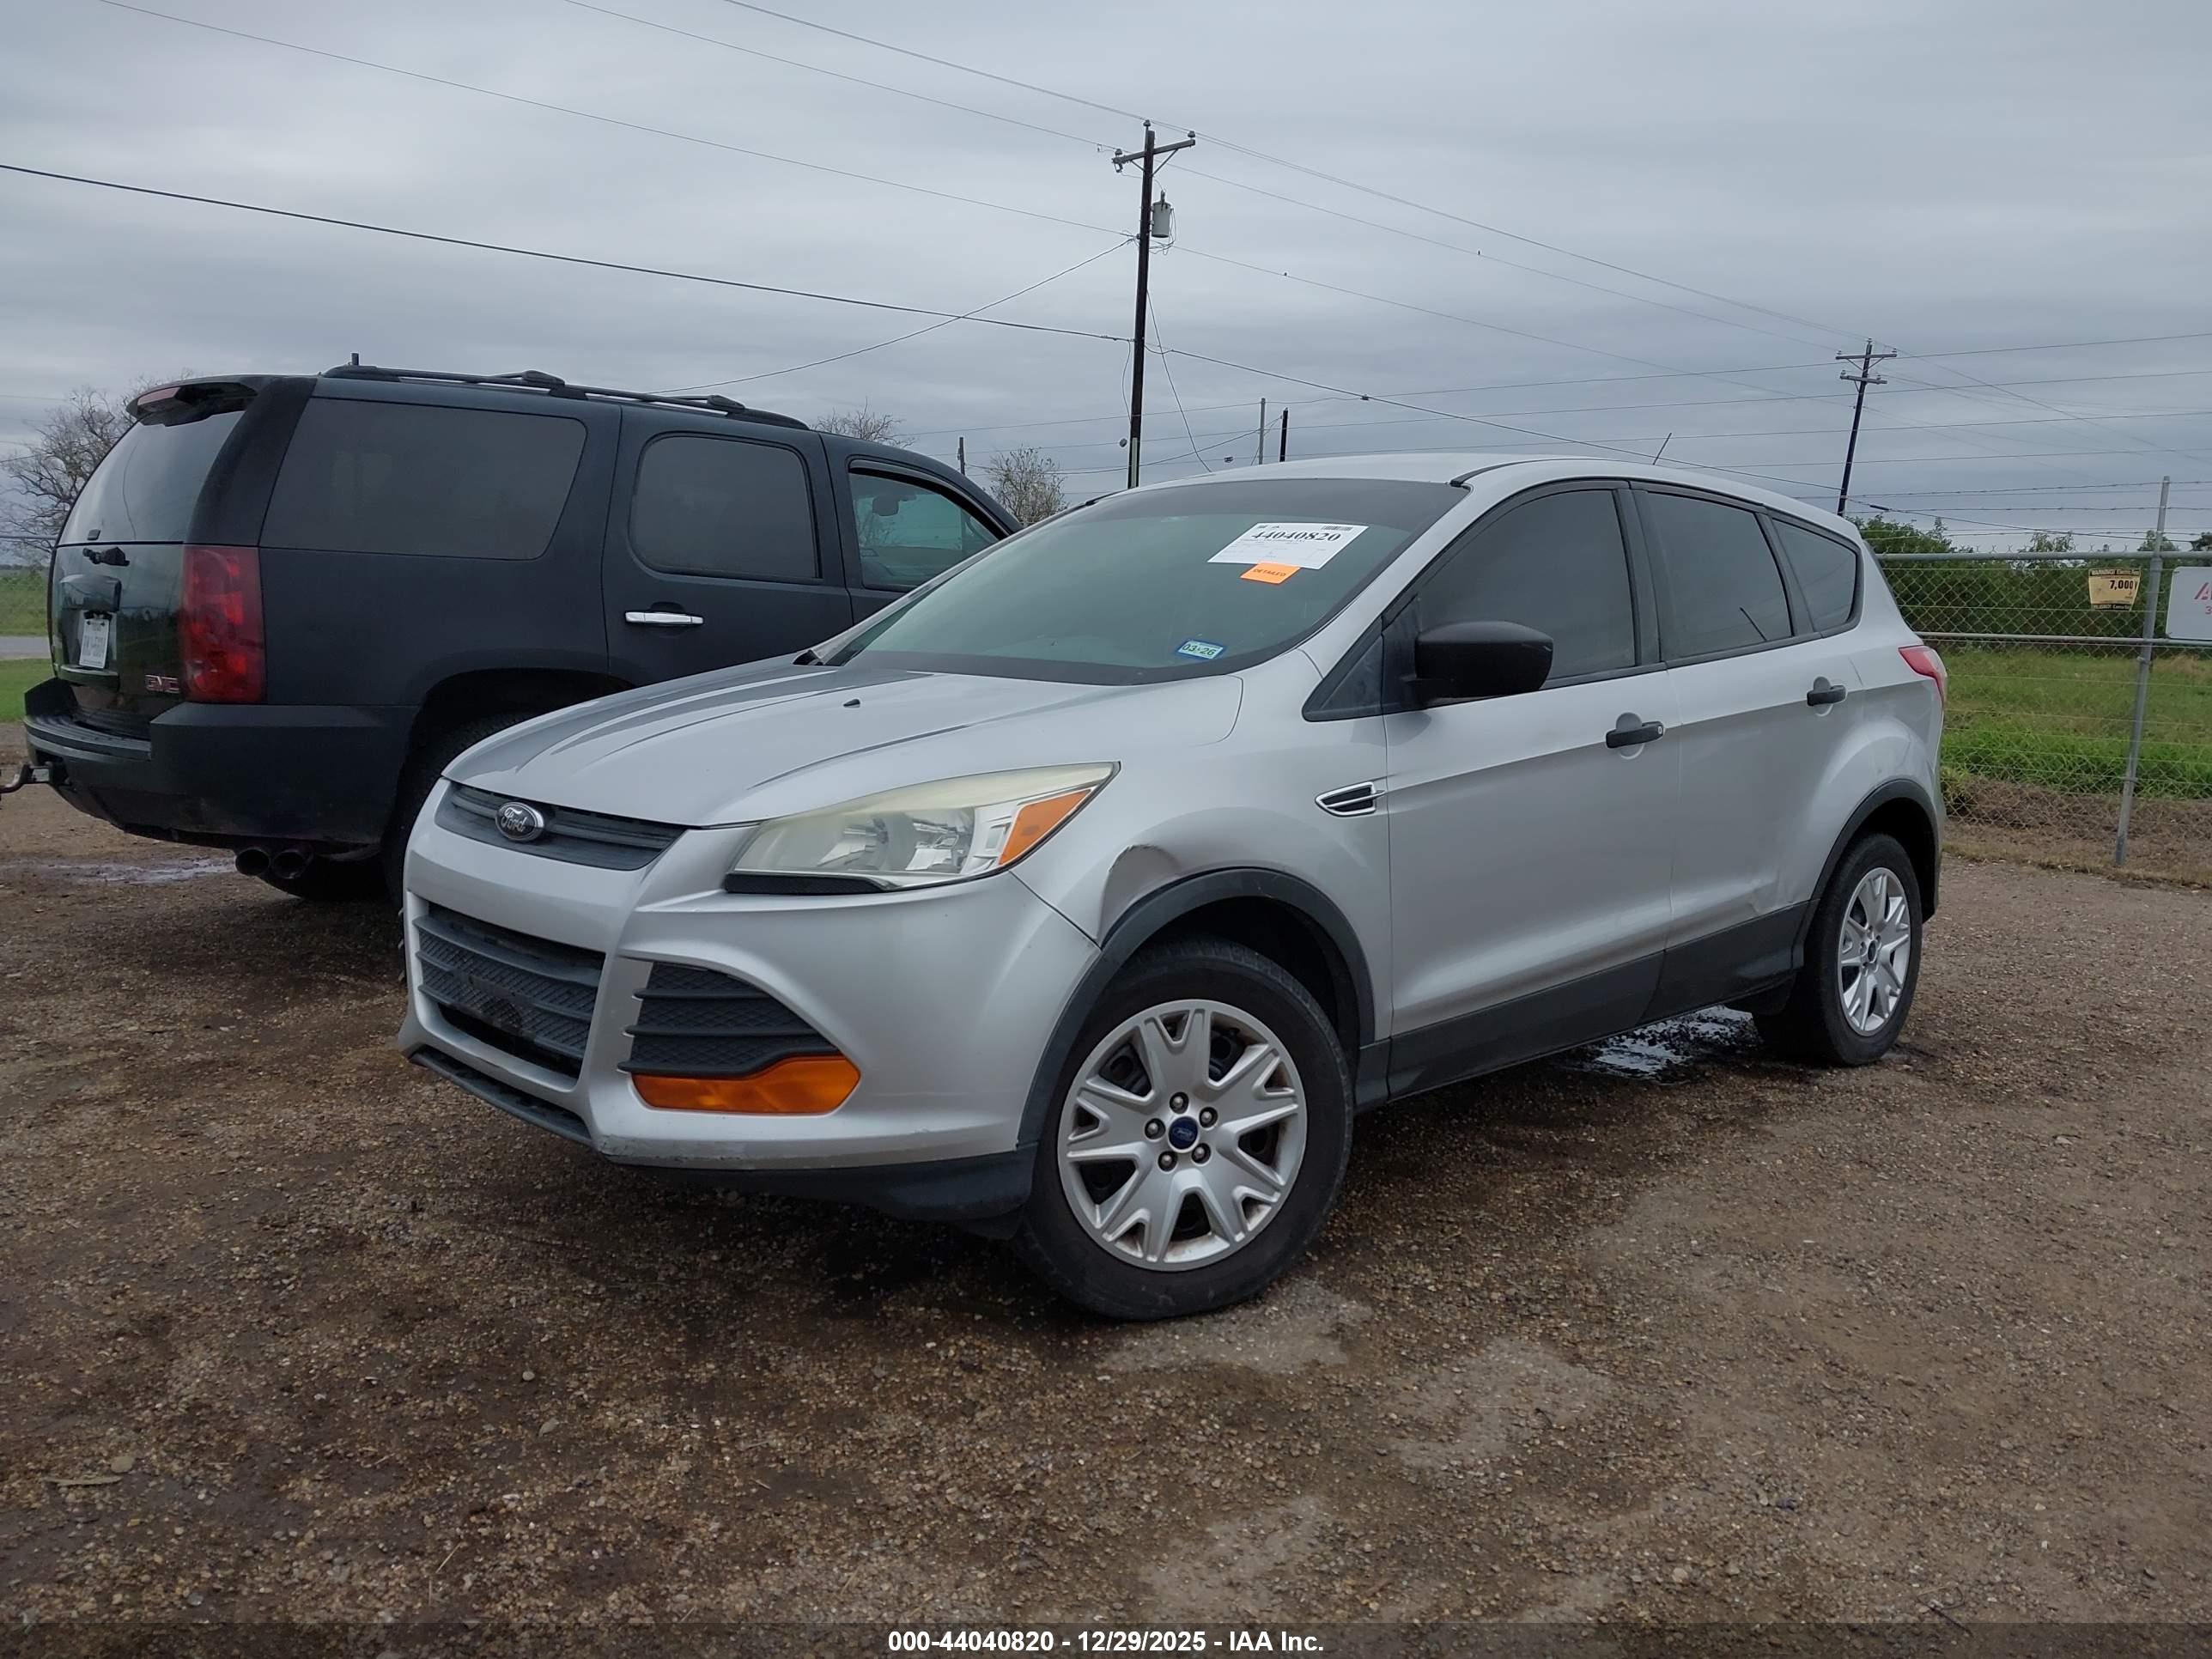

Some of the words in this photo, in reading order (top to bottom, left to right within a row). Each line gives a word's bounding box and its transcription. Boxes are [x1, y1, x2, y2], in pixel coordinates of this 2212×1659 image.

[1251, 530, 1341, 543] 44040820
[2109, 580, 2134, 591] 7,000
[144, 674, 179, 694] GMC
[500, 806, 528, 833] Ford
